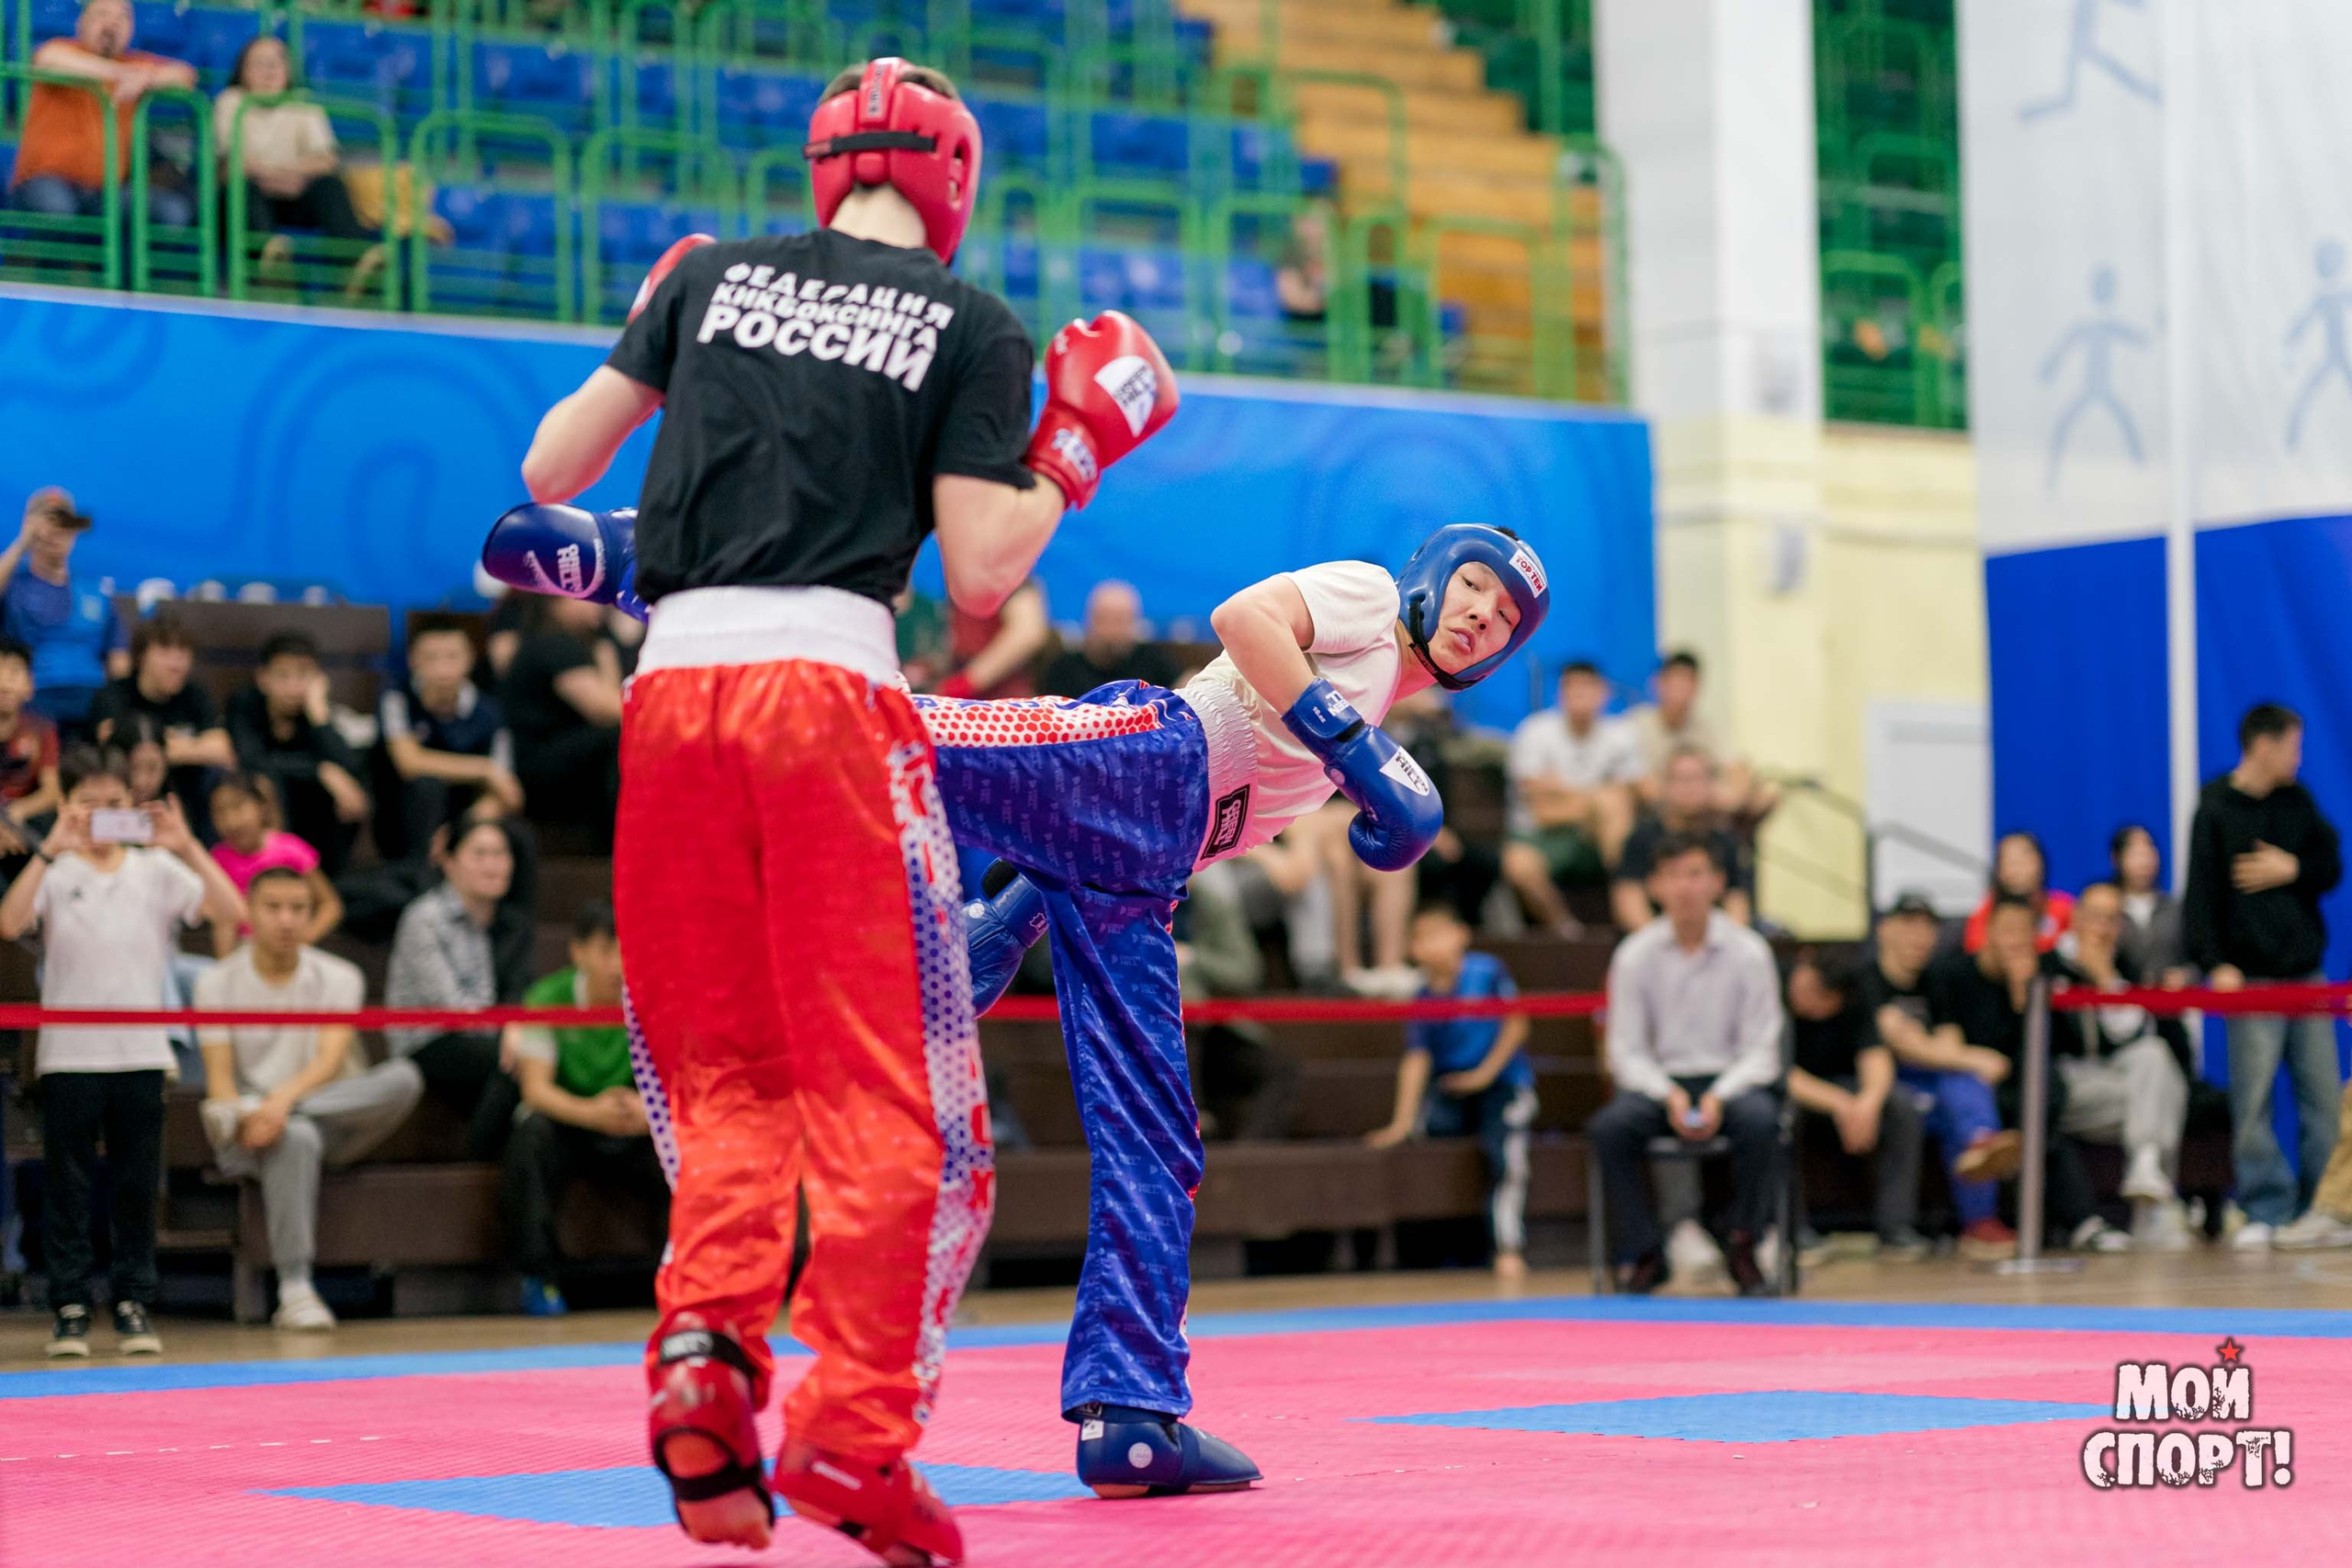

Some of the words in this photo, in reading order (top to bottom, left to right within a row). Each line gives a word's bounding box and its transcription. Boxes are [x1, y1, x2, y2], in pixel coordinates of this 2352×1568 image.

[696, 304, 934, 391] РОССИИ
[1516, 555, 1532, 573] TOP
[1531, 571, 1544, 592] TEN
[1214, 806, 1233, 845] HILL
[1219, 799, 1241, 846] GREEN
